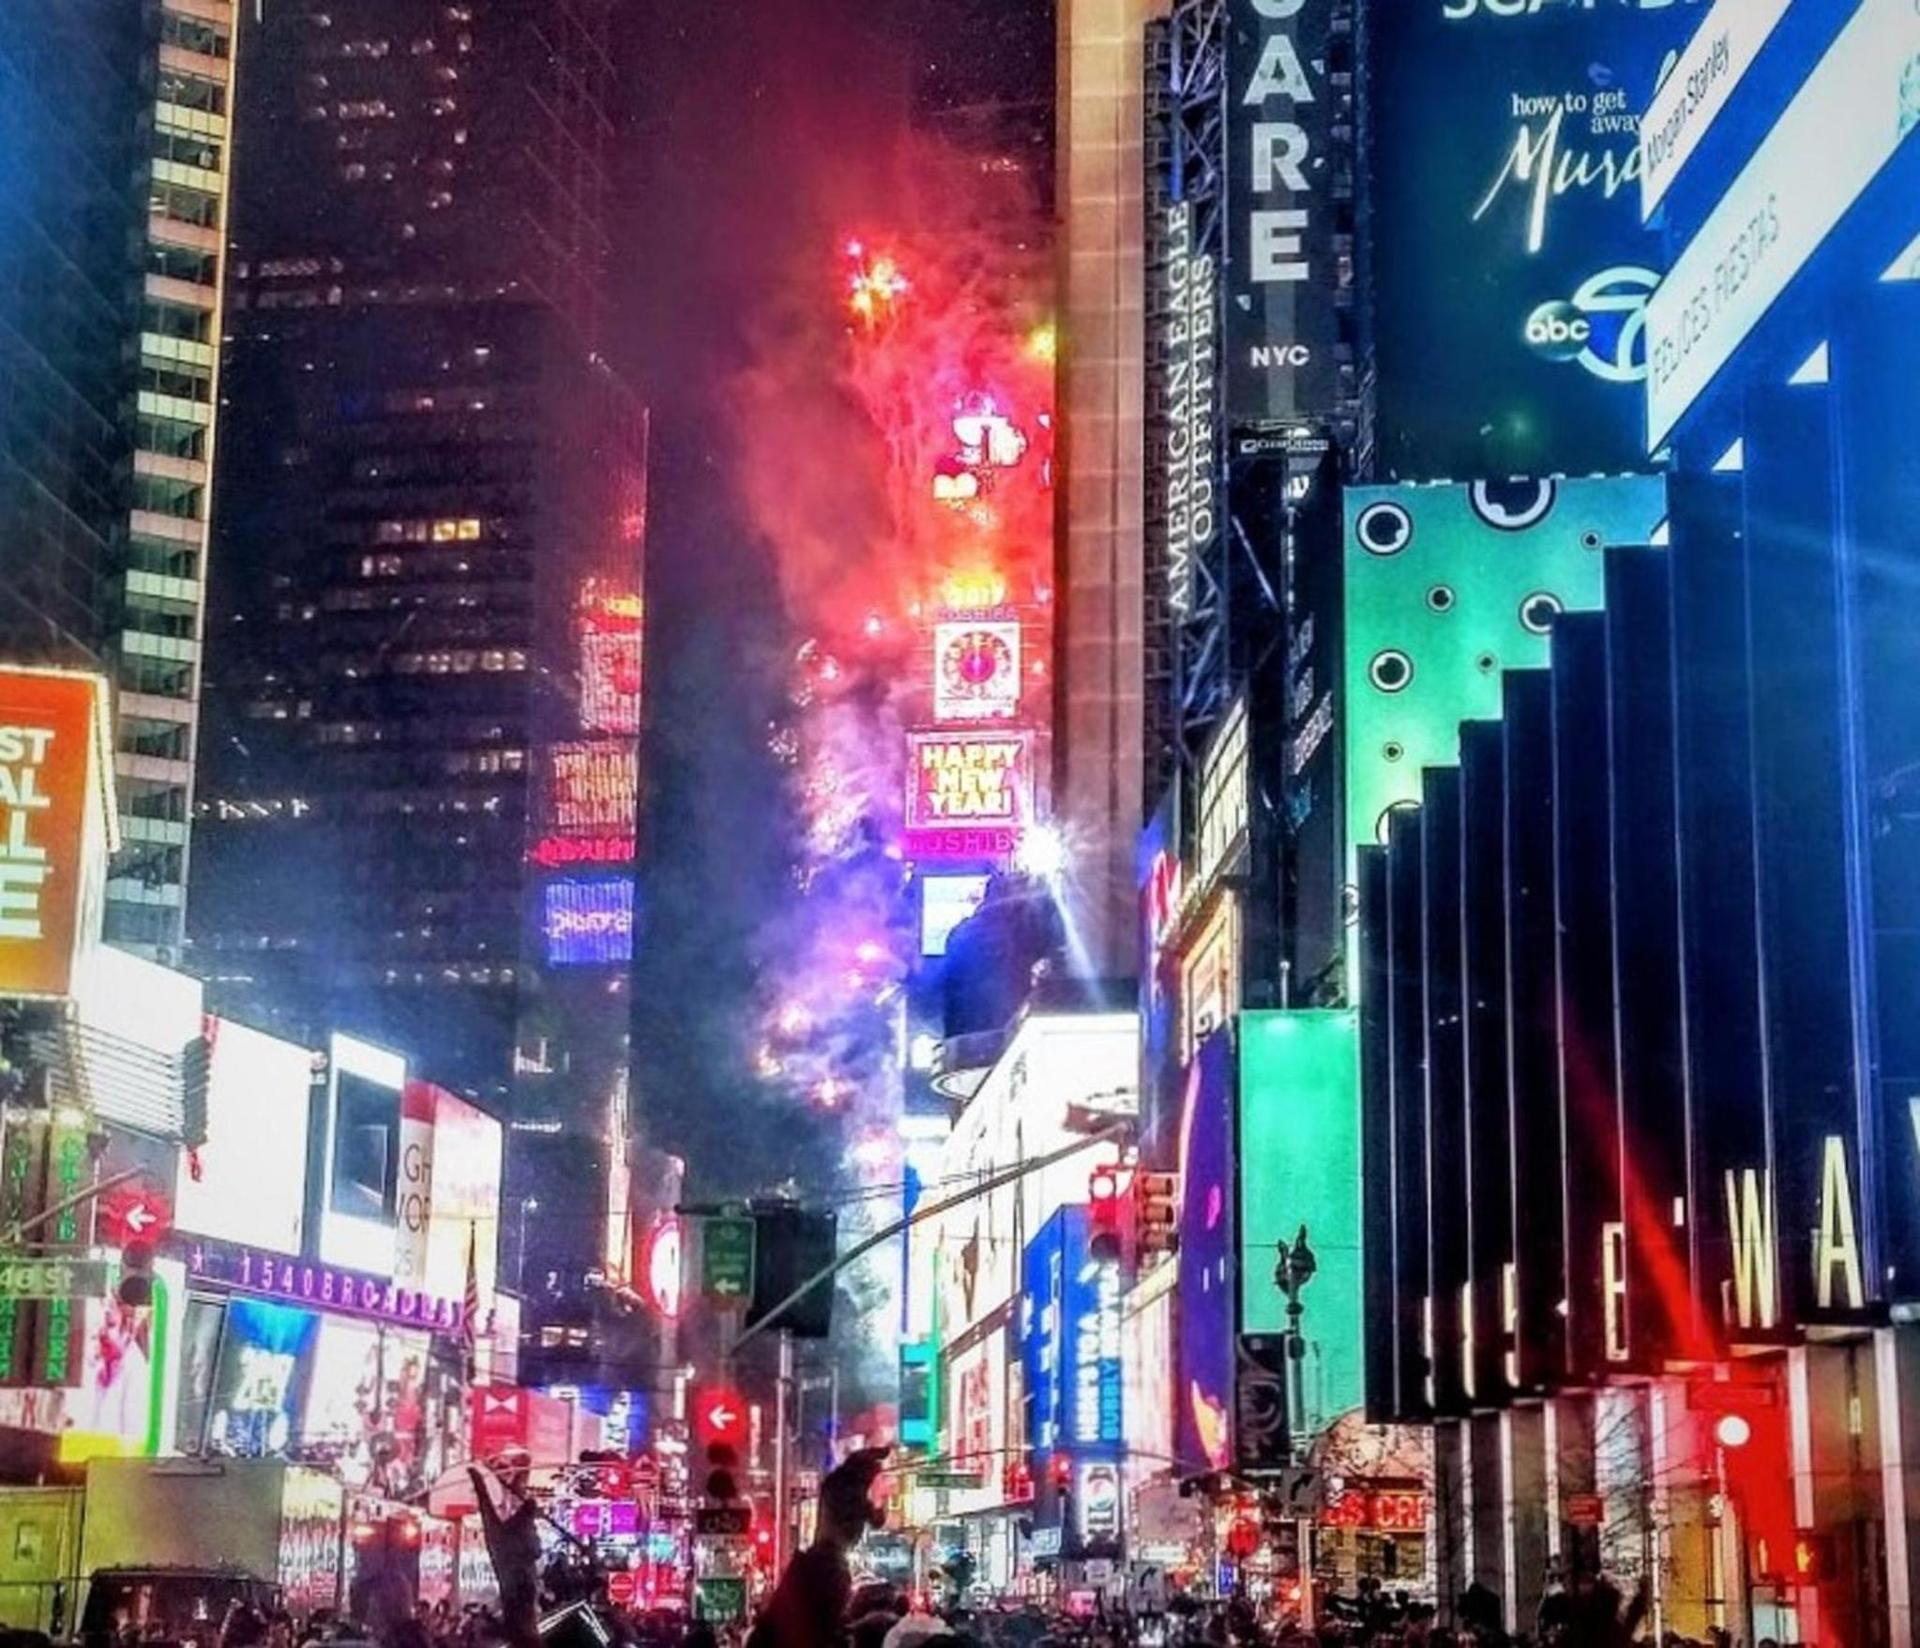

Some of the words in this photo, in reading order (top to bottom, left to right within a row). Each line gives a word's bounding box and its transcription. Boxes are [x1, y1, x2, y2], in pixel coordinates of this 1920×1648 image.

[1512, 92, 1557, 117] how
[1564, 89, 1588, 112] to
[1592, 87, 1627, 116] get
[1167, 201, 1190, 346] EAGLE
[1523, 312, 1591, 343] abc
[1250, 345, 1310, 368] NYC
[1191, 253, 1215, 541] OUTFITTERS
[1167, 363, 1190, 615] AMERICAN
[922, 743, 1024, 768] HAPPY
[937, 768, 1006, 793] NEW
[1101, 1360, 1119, 1440] BUBBLY
